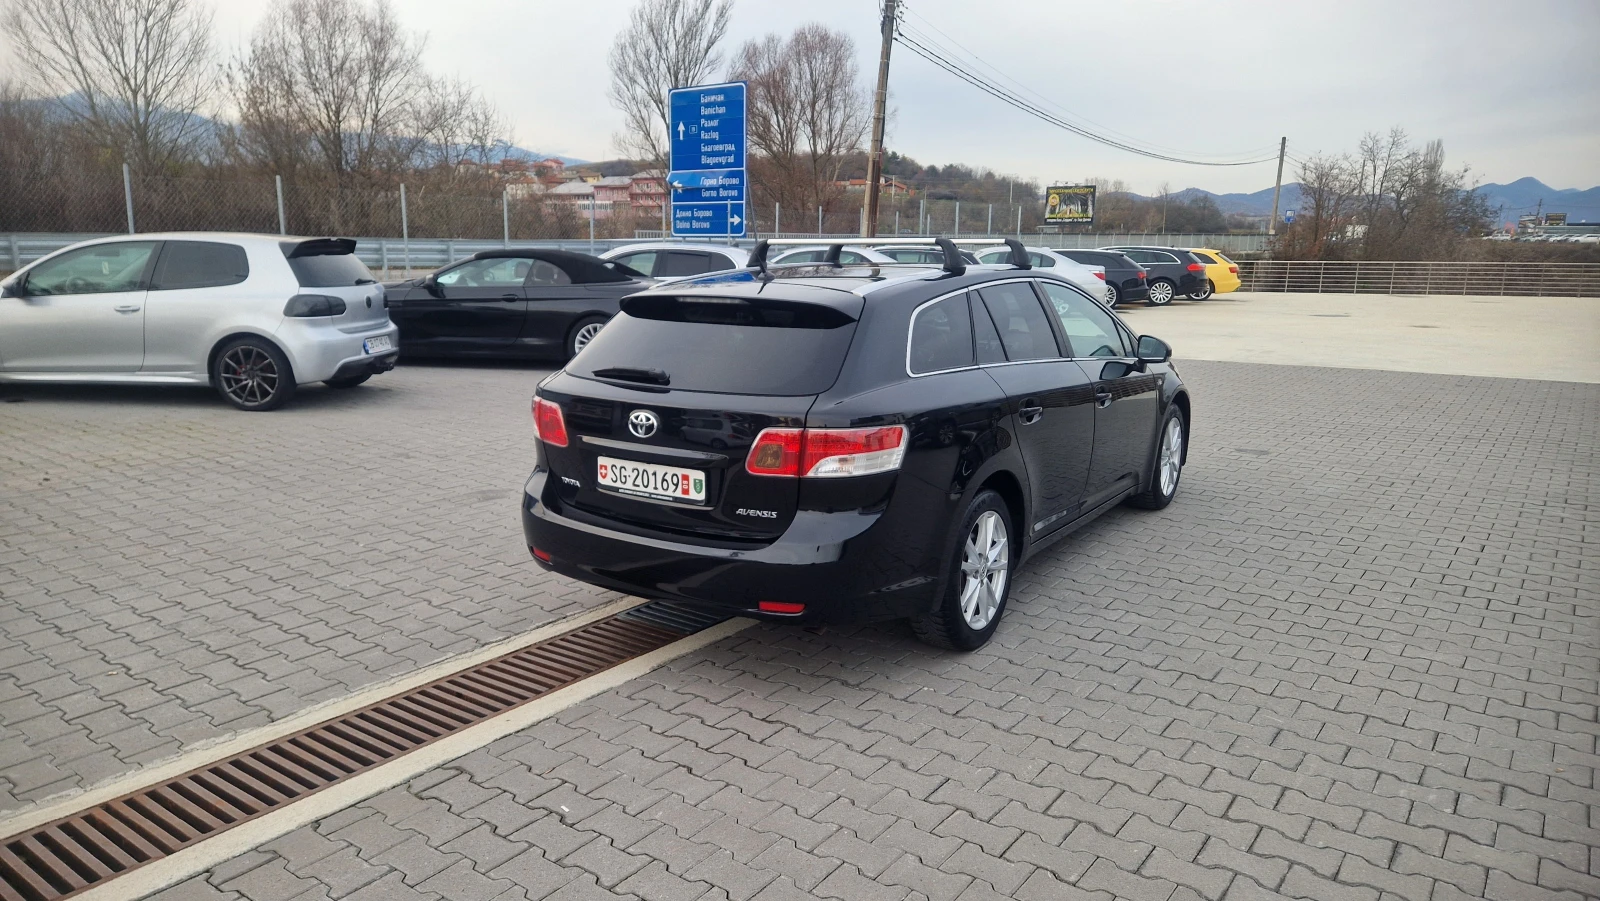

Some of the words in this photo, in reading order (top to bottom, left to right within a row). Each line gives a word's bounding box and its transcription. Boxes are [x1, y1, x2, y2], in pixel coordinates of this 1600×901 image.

[700, 94, 724, 103] Баничан
[700, 105, 726, 116] Banichan
[700, 118, 720, 128] Разлог
[700, 130, 719, 140] Razlog
[700, 143, 736, 152] Благоевград
[701, 154, 734, 165] Blagoevgrad
[718, 176, 739, 186] Борово
[701, 189, 717, 198] Gorno
[719, 188, 738, 197] Borovo
[694, 208, 712, 218] Борово
[676, 220, 690, 229] Dolno
[692, 220, 710, 229] Borovo
[736, 508, 778, 518] AVENSIS
